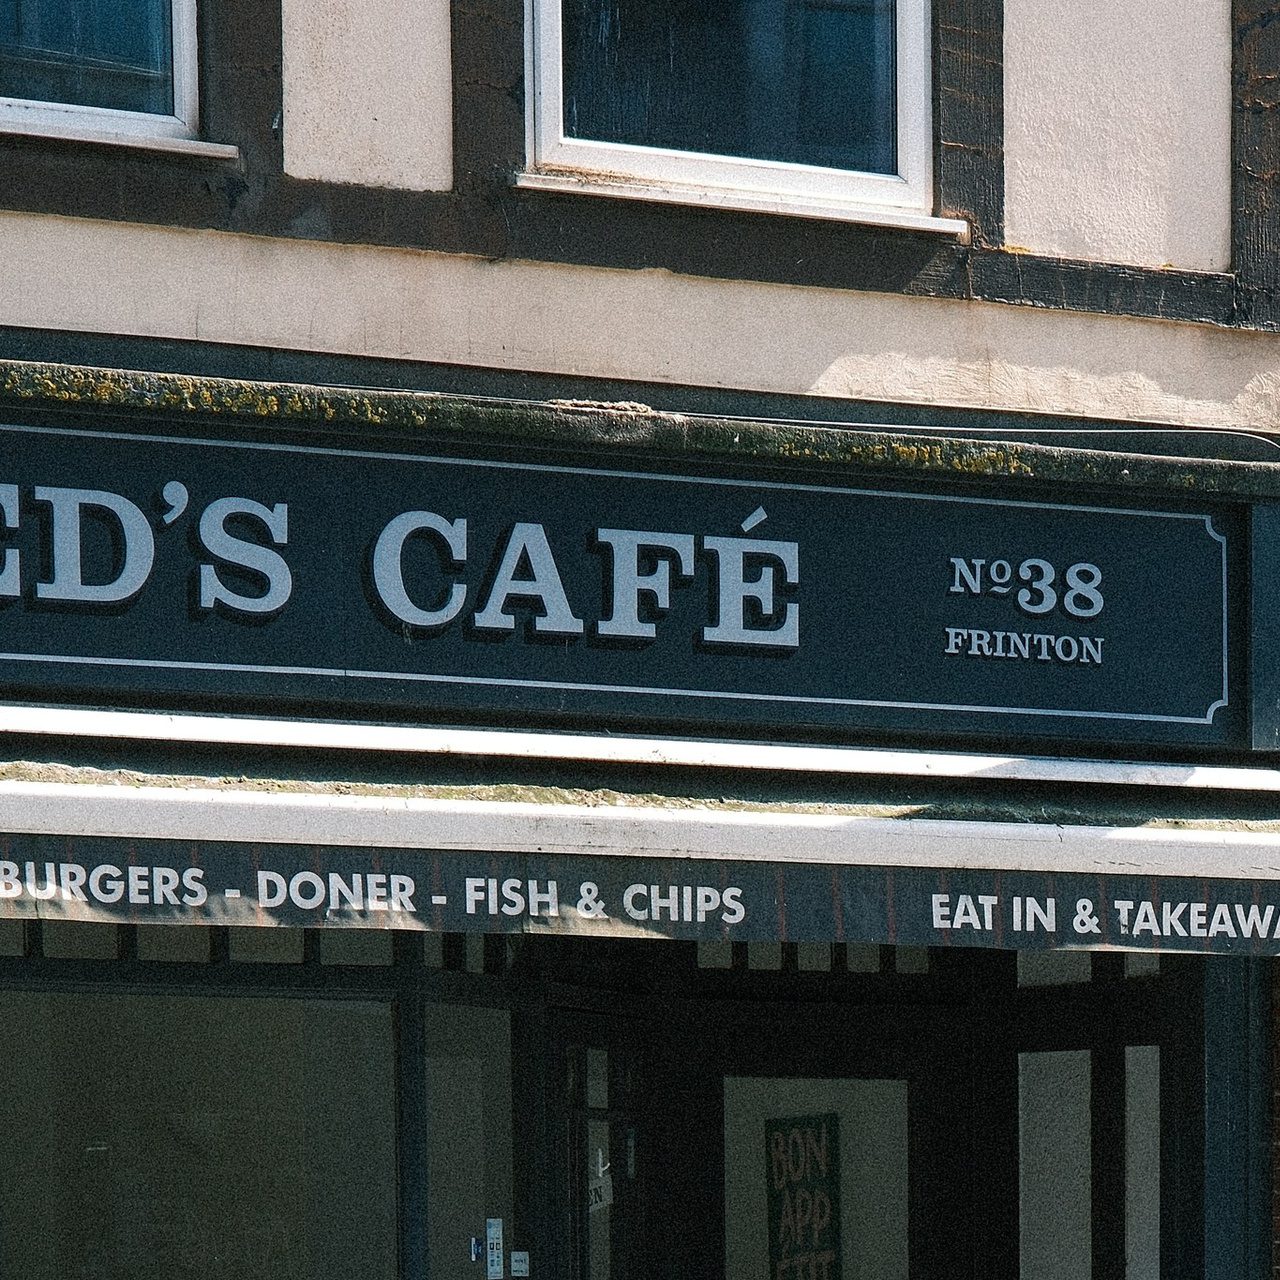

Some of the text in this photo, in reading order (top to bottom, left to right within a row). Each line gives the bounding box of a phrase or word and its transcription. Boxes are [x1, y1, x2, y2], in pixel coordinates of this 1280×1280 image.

[0, 481, 801, 647] D'S CAFÉ
[944, 627, 1105, 665] FRINTON
[0, 859, 207, 906] BURGERS
[257, 870, 417, 914] DONER
[465, 876, 558, 918] FISH
[577, 881, 610, 920] &
[622, 884, 746, 926] CHIPS
[932, 893, 998, 931] EAT
[1013, 895, 1056, 933] IN
[1072, 897, 1100, 935] &
